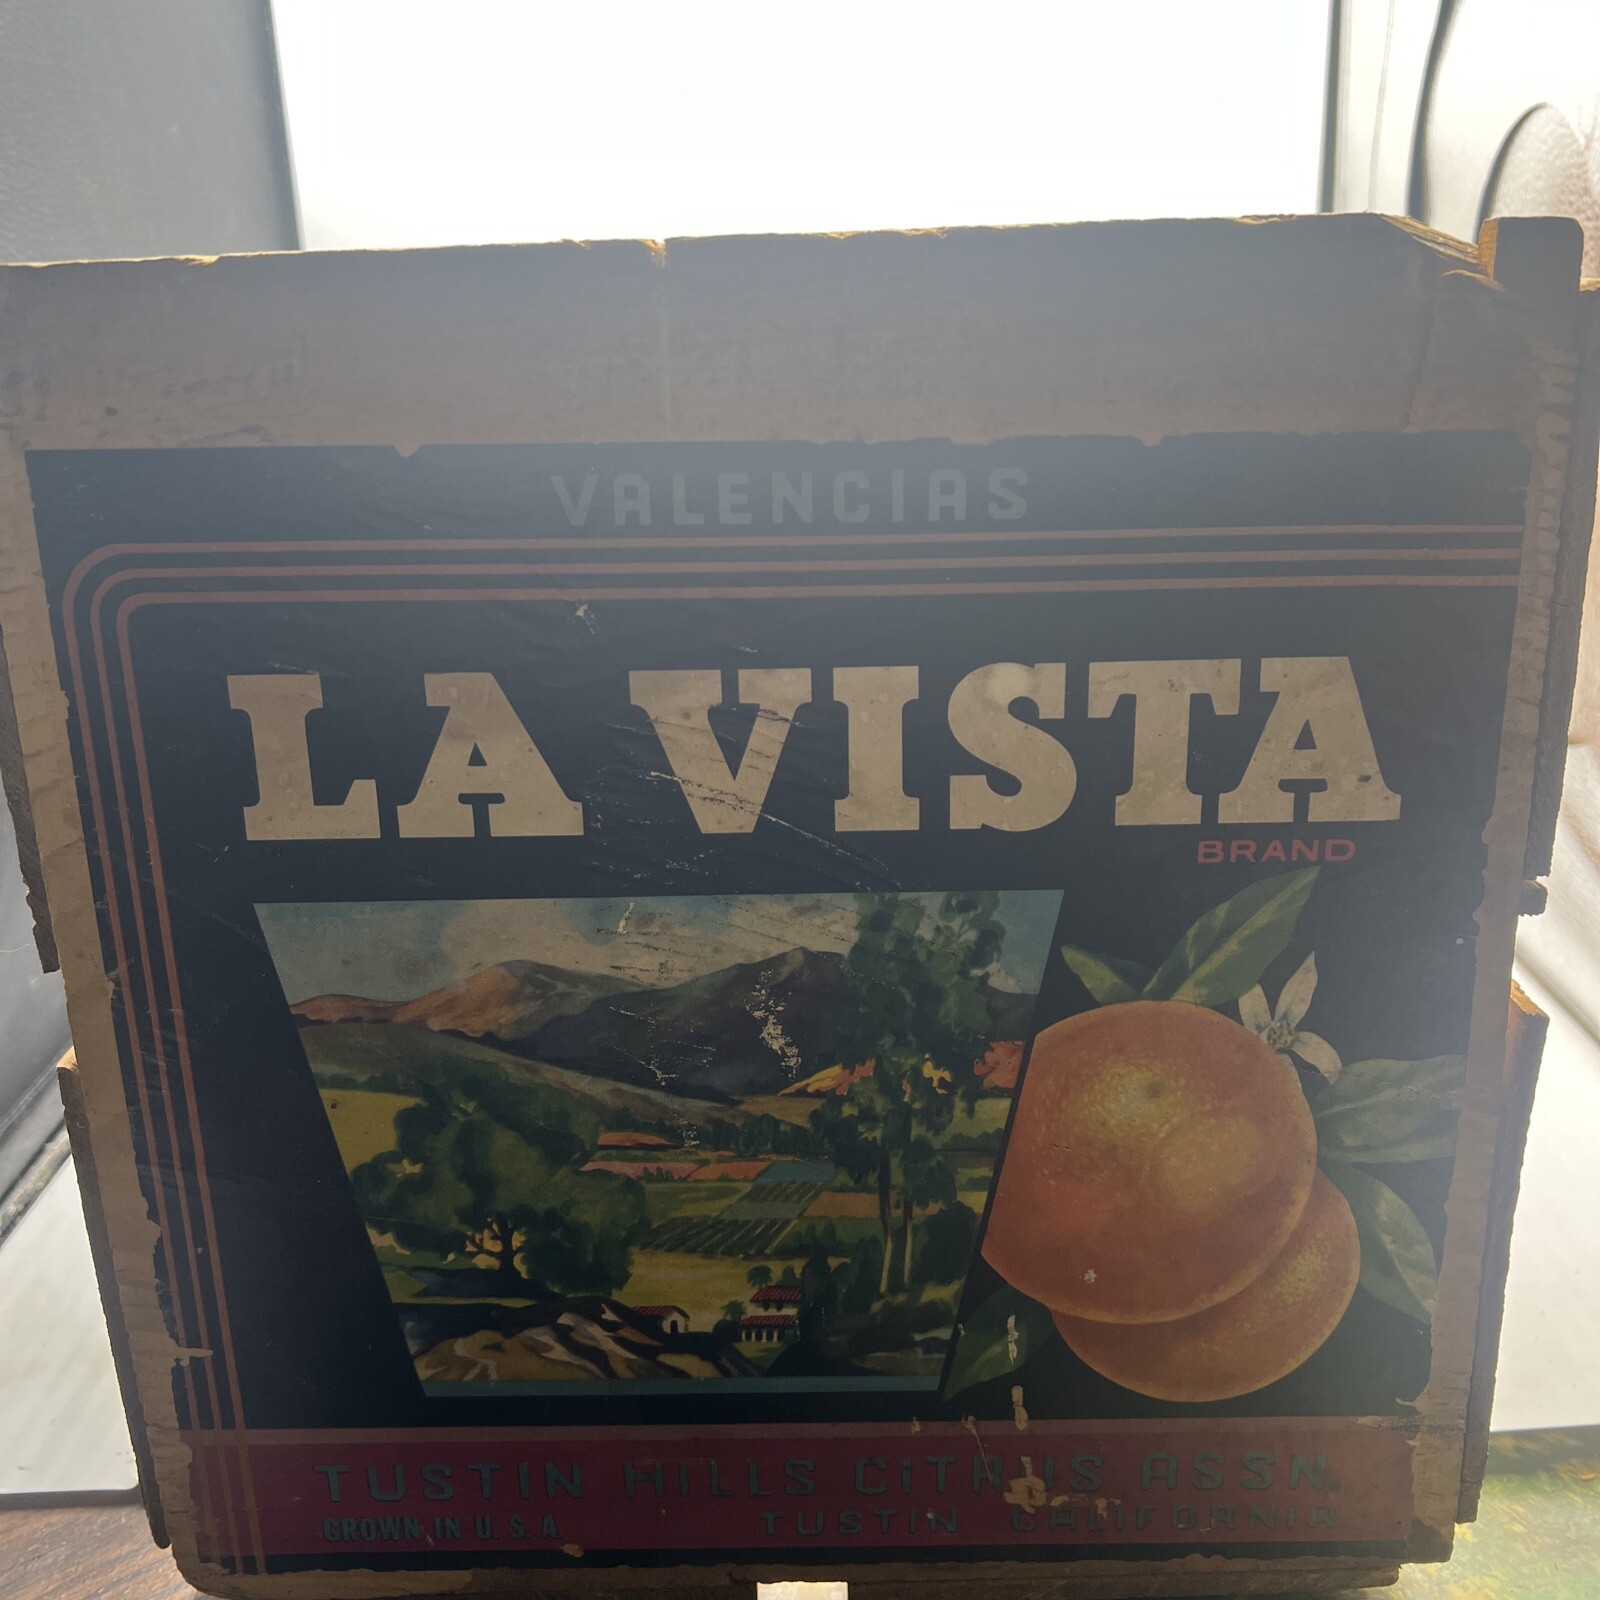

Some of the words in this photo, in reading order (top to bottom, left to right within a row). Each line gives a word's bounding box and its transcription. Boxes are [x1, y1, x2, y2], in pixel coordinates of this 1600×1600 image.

[551, 467, 1029, 526] VALENCIAS
[226, 672, 584, 841] LA
[628, 656, 1402, 835] VISTA
[1197, 839, 1357, 864] BRAND
[315, 1462, 583, 1502] TUSTIN
[622, 1457, 818, 1498] HILLS
[322, 1517, 420, 1542] GROWN
[434, 1515, 463, 1539] IN
[760, 1508, 960, 1535] TUSTIN
[1010, 1503, 1338, 1533] CALIFORNIA
